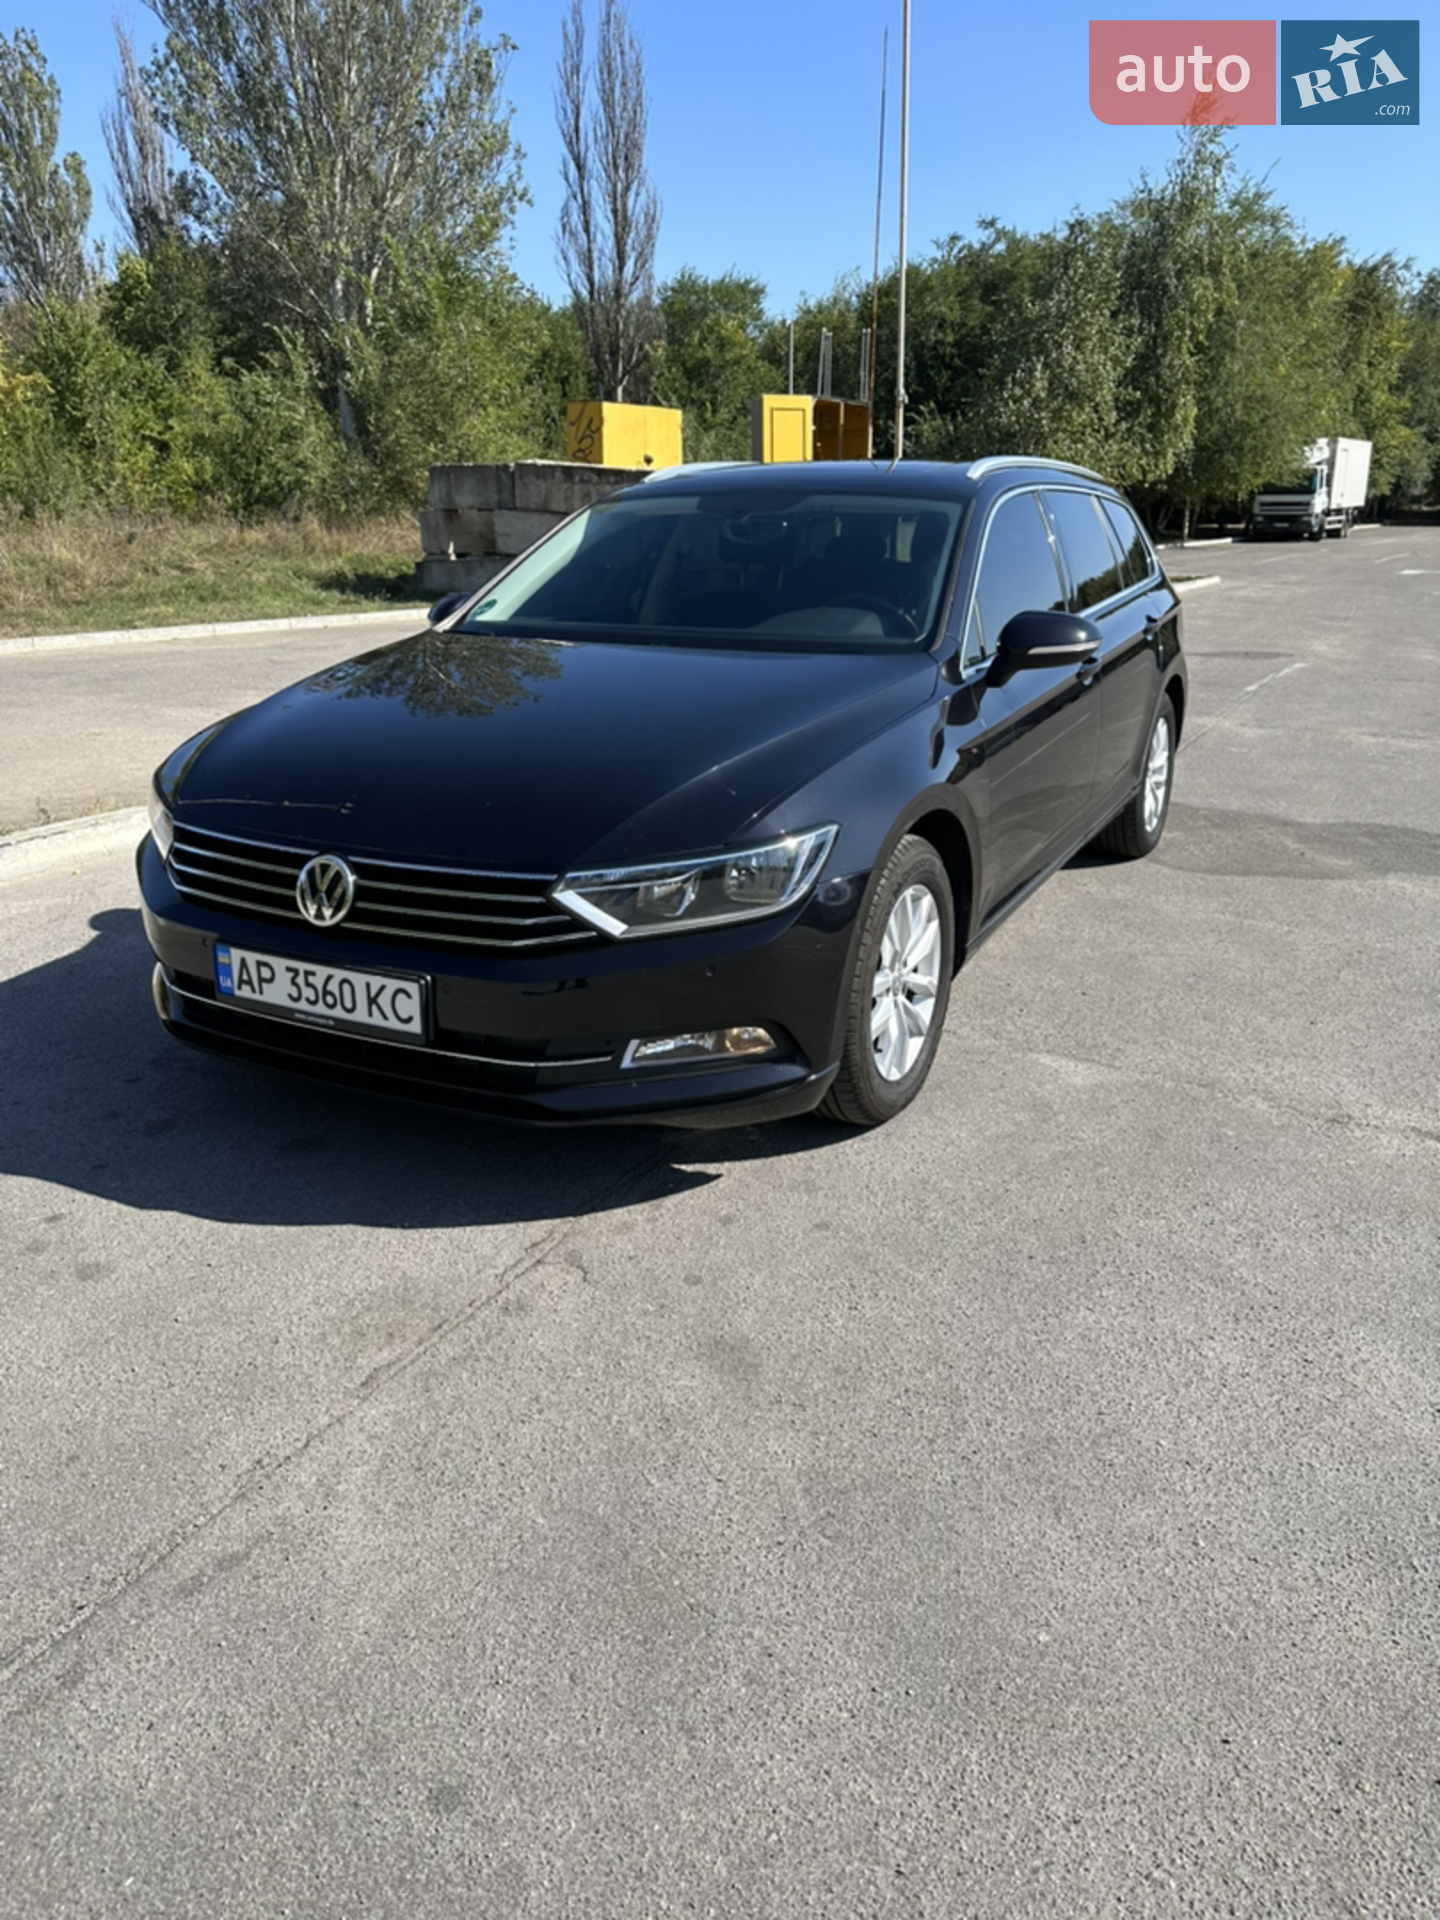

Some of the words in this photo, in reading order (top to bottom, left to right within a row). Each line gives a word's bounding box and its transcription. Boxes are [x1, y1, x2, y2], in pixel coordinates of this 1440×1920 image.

[236, 956, 276, 996] AP
[285, 966, 357, 1015] 3560
[365, 981, 414, 1025] KC
